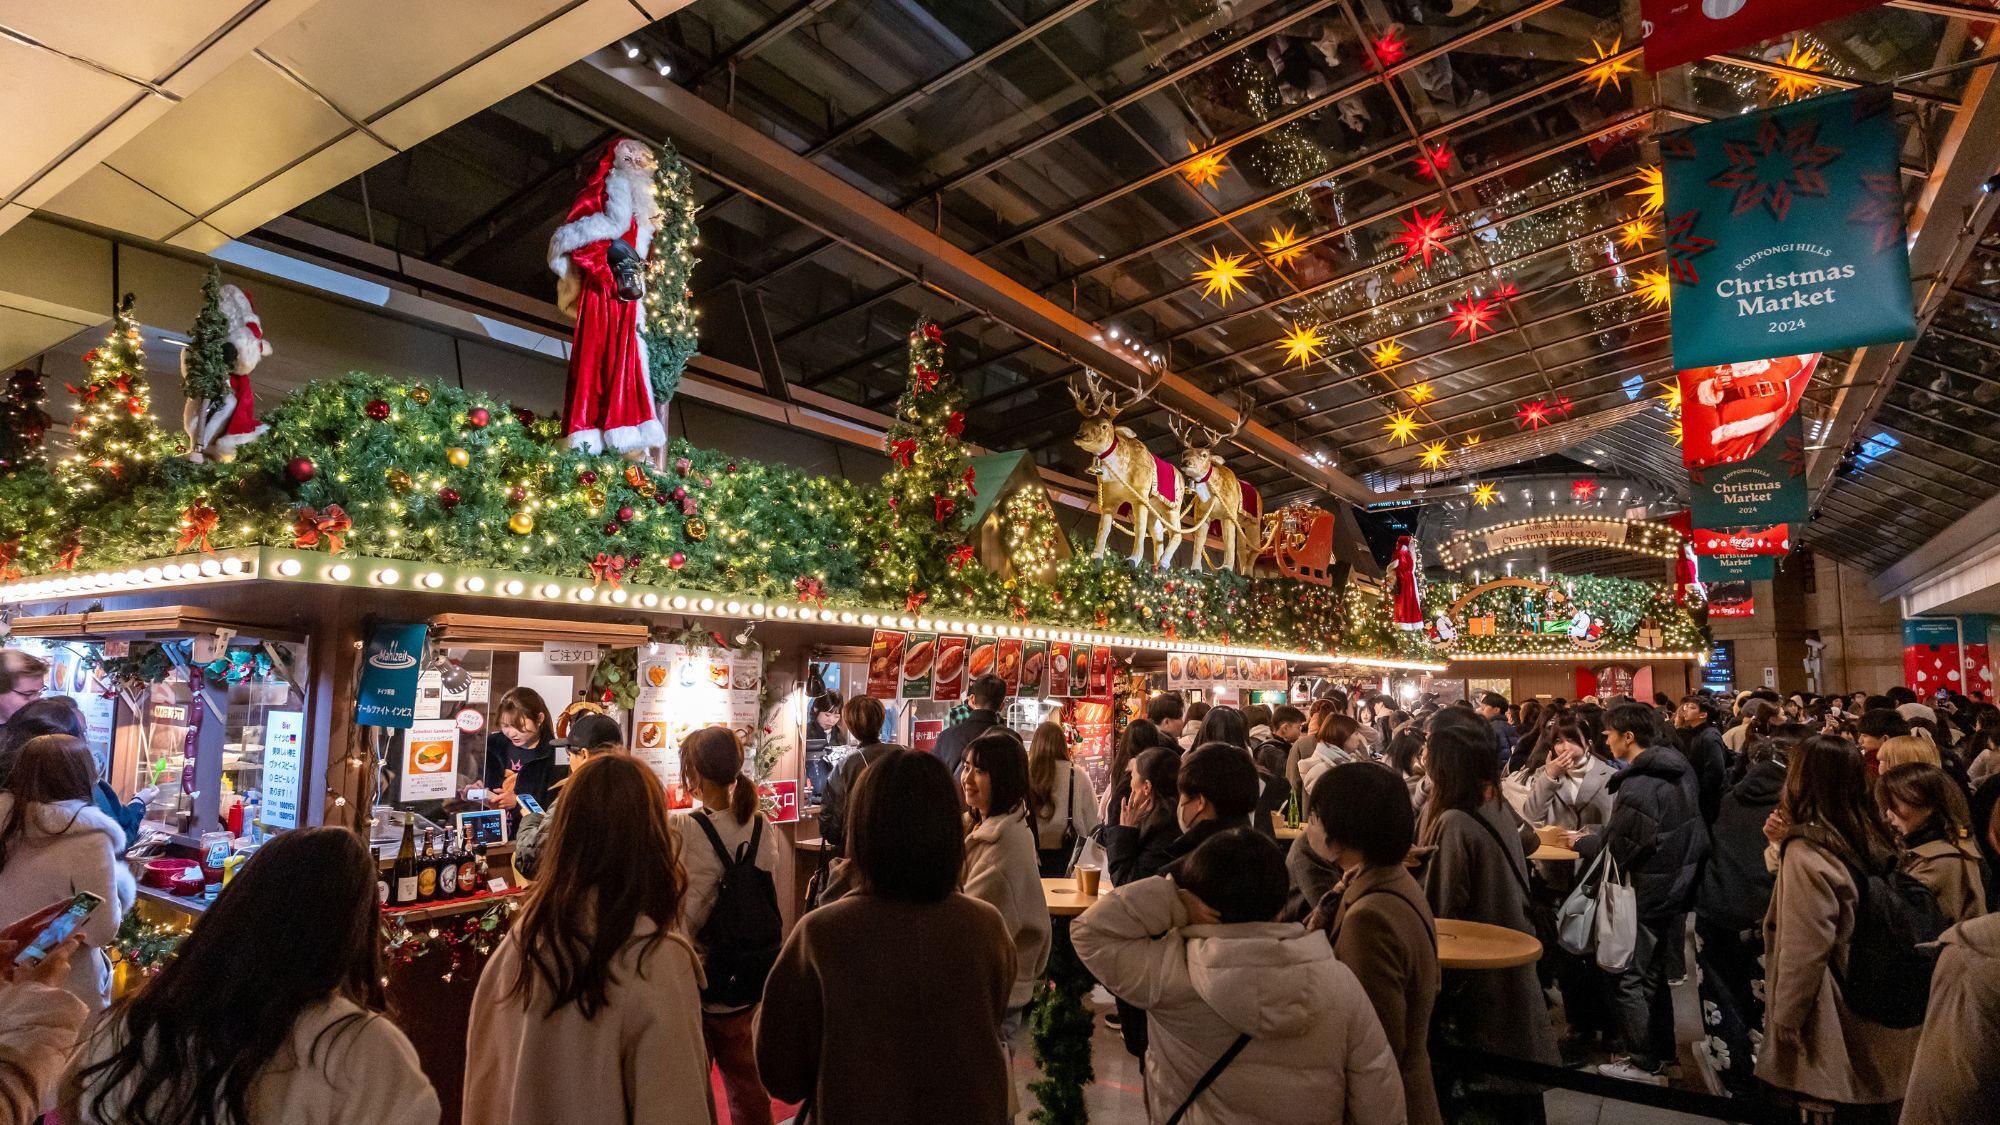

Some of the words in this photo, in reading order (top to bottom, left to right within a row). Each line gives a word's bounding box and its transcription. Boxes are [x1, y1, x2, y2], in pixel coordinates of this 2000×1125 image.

[1735, 244, 1794, 271] ROPPONGI
[1796, 243, 1833, 257] HILLS
[1716, 264, 1856, 298] Christmas
[1737, 287, 1836, 317] Market
[1768, 318, 1806, 333] 2024
[1712, 481, 1781, 493] Christmas
[1723, 492, 1772, 504] Market
[1502, 531, 1549, 545] Christmas
[1550, 530, 1585, 539] Market
[1586, 530, 1607, 538] 2024
[549, 649, 593, 661] ご注文口
[391, 706, 412, 717] インビス
